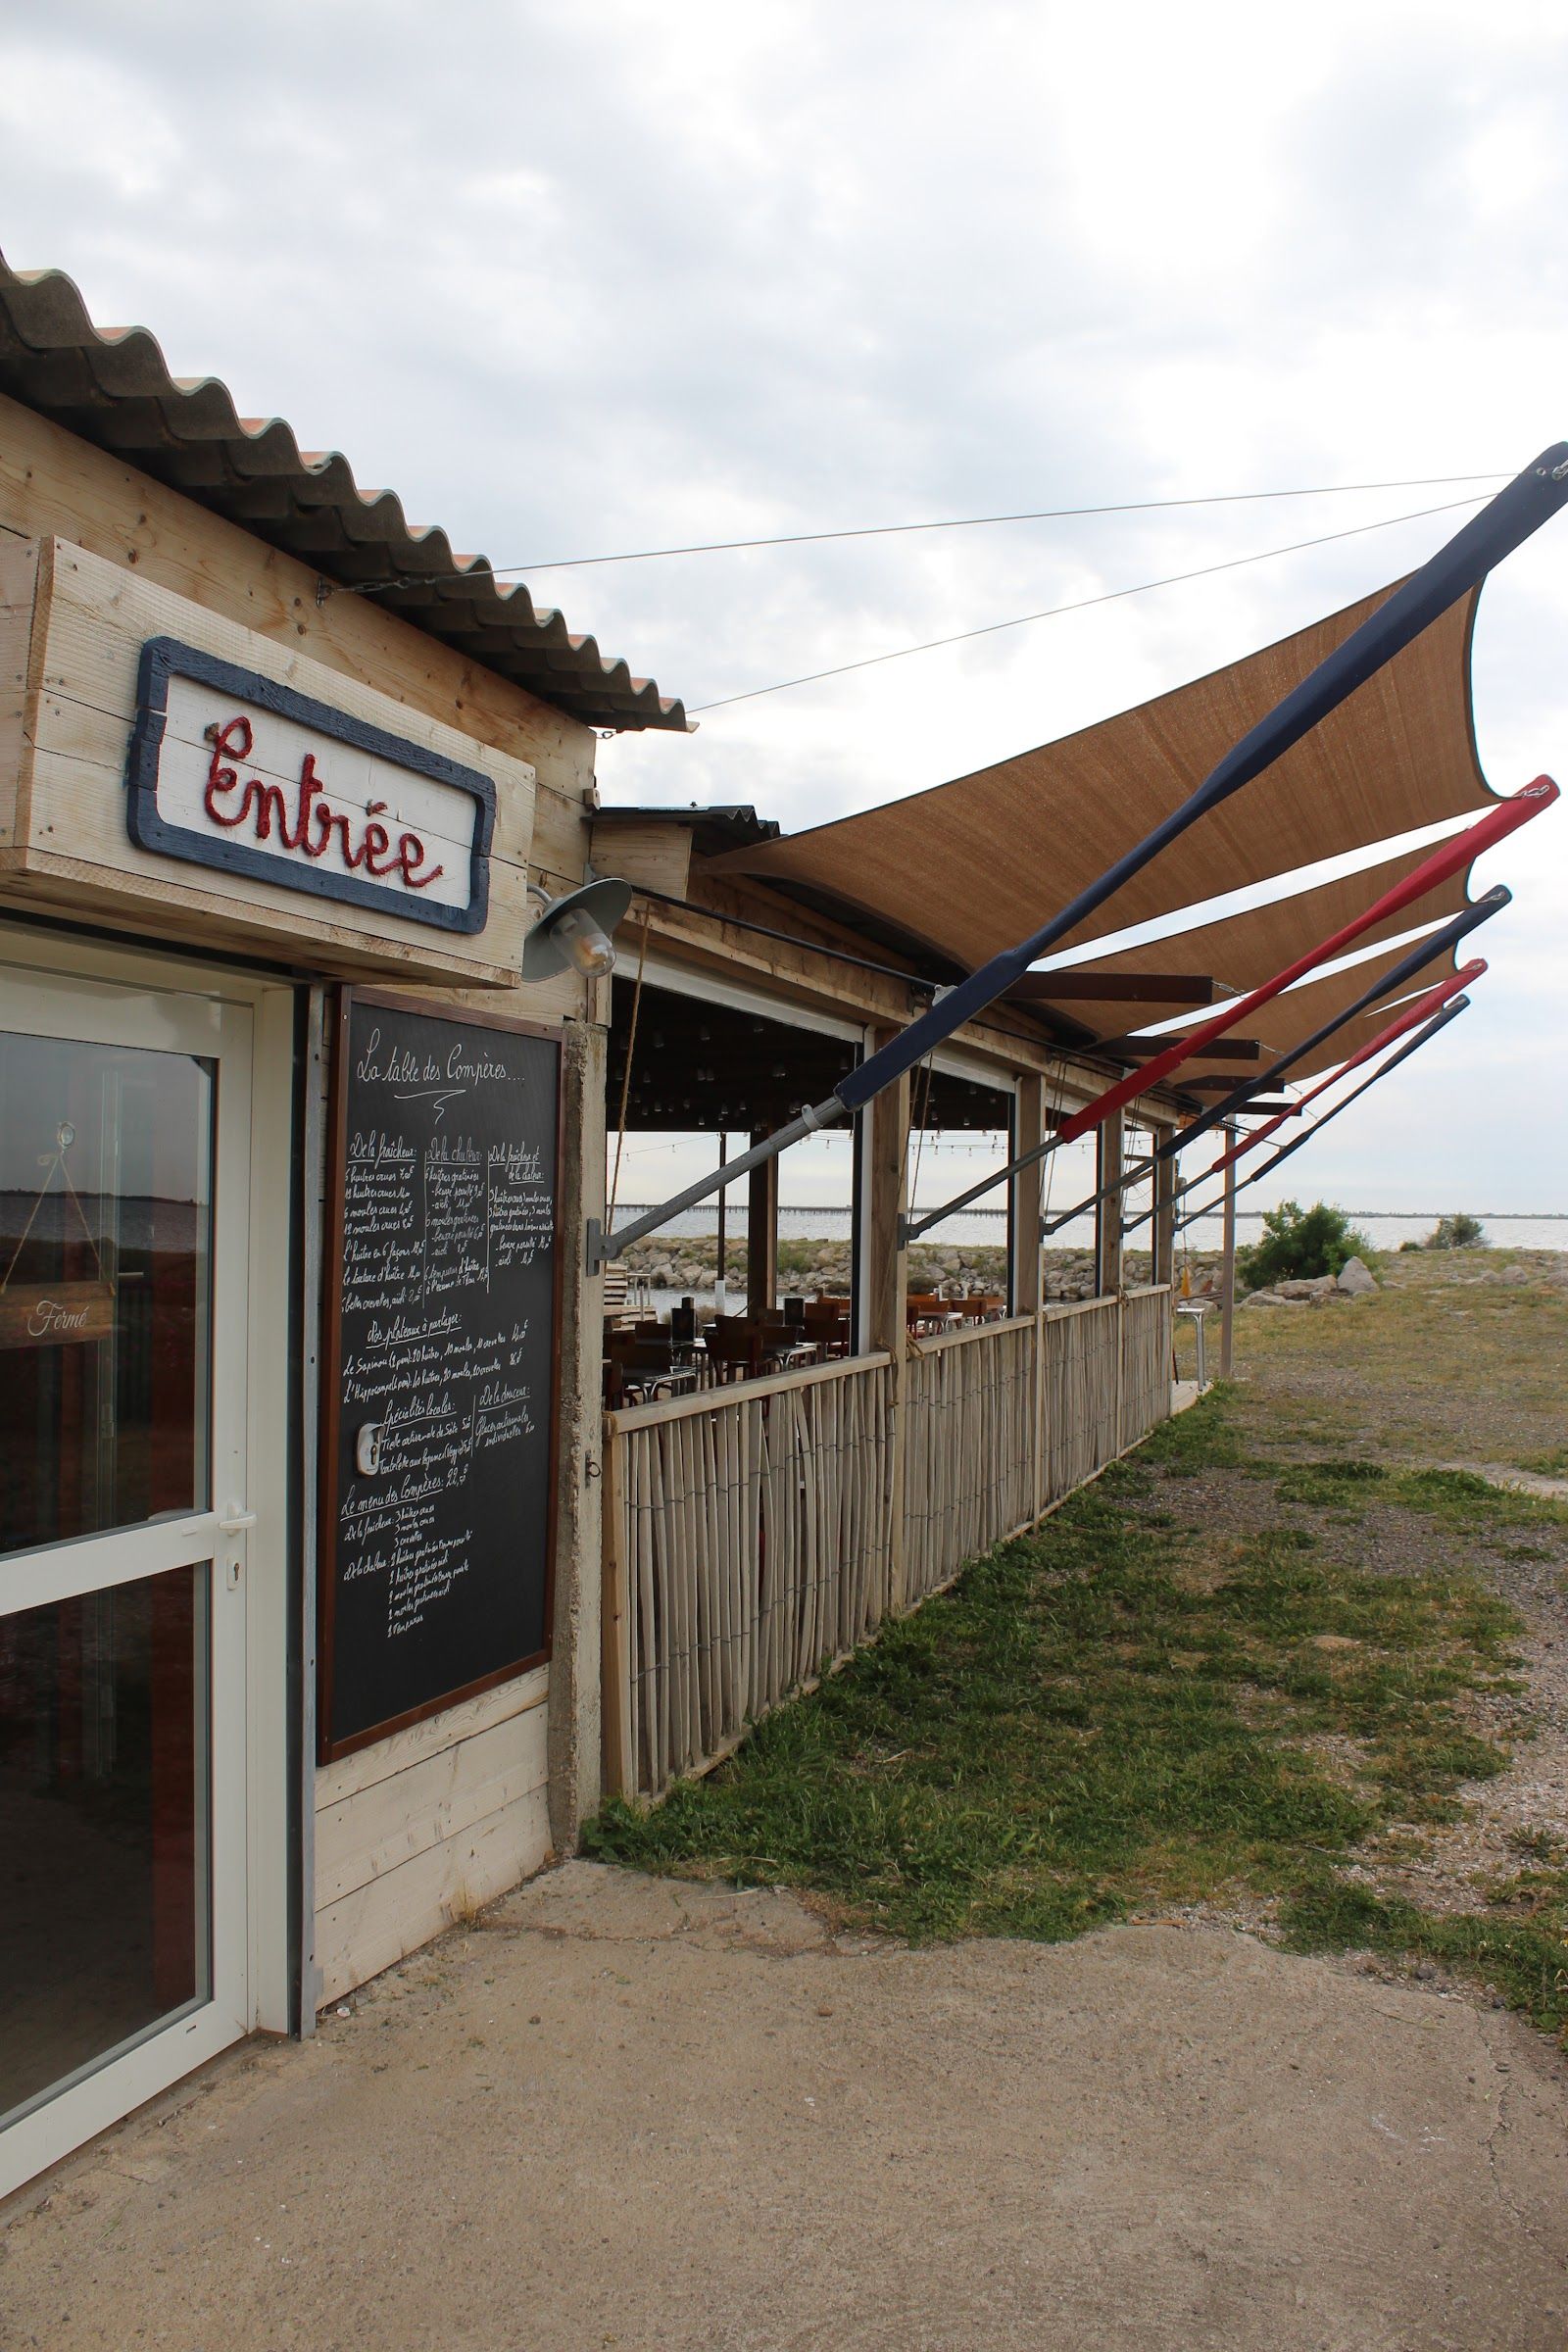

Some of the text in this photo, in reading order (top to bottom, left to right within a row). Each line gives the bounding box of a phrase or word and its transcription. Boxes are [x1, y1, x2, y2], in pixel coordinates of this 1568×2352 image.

[204, 714, 444, 888] Entrée
[357, 1028, 381, 1082] La
[382, 1046, 419, 1082] table
[422, 1054, 441, 1082] des
[350, 1132, 368, 1158] De
[368, 1129, 375, 1158] la
[427, 1137, 440, 1160] De
[440, 1135, 449, 1161] la
[489, 1145, 500, 1162] De
[350, 1200, 377, 1217] moules
[353, 1215, 380, 1234] moules
[27, 1299, 90, 1337] Fermé
[383, 1315, 420, 1350] plateaux
[421, 1317, 428, 1332] à
[343, 1354, 354, 1377] Le
[479, 1384, 492, 1406] De
[409, 1456, 421, 1468] aux
[340, 1484, 356, 1516] Le
[357, 1497, 385, 1512] menu
[385, 1485, 399, 1504] des
[344, 1525, 356, 1542] De
[395, 1510, 402, 1524] 3
